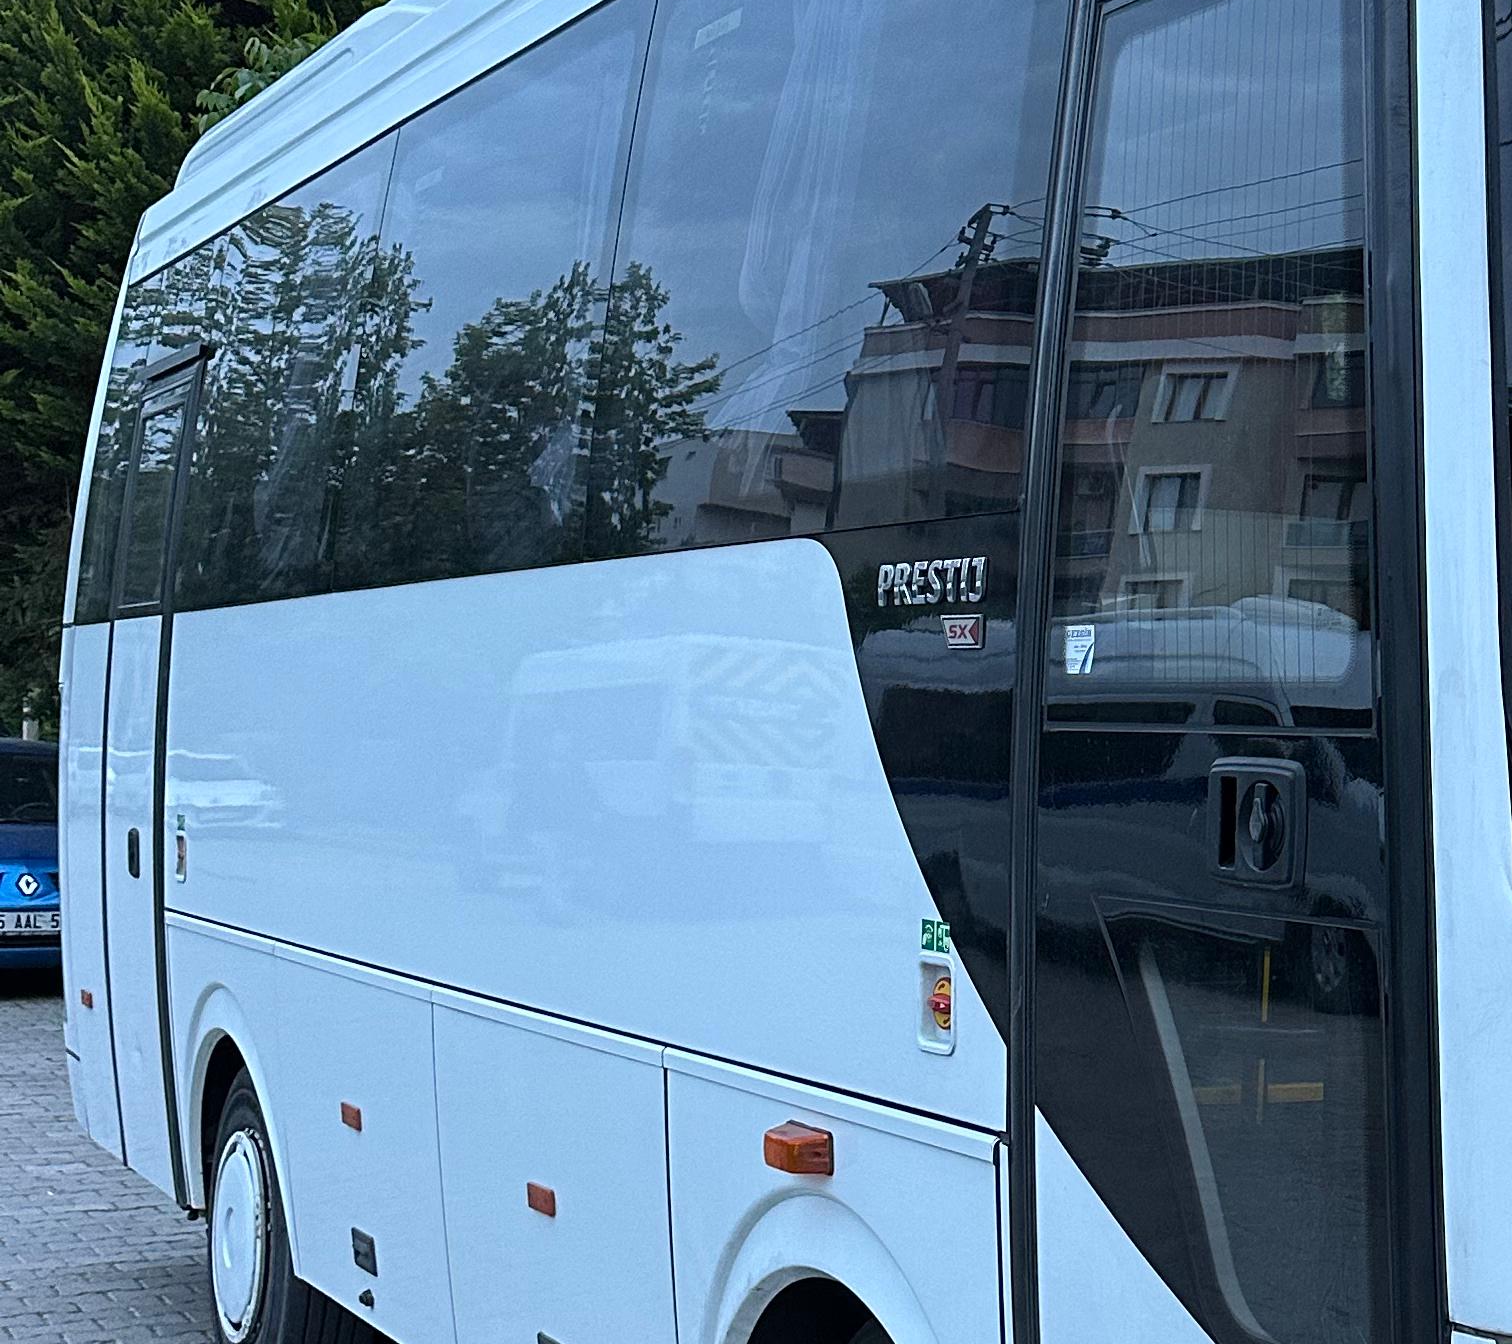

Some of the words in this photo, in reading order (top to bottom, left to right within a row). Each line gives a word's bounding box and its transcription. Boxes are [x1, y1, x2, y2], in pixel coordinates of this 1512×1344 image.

[877, 556, 987, 607] PRESTIJ
[948, 624, 969, 640] SX
[14, 913, 42, 929] AAL
